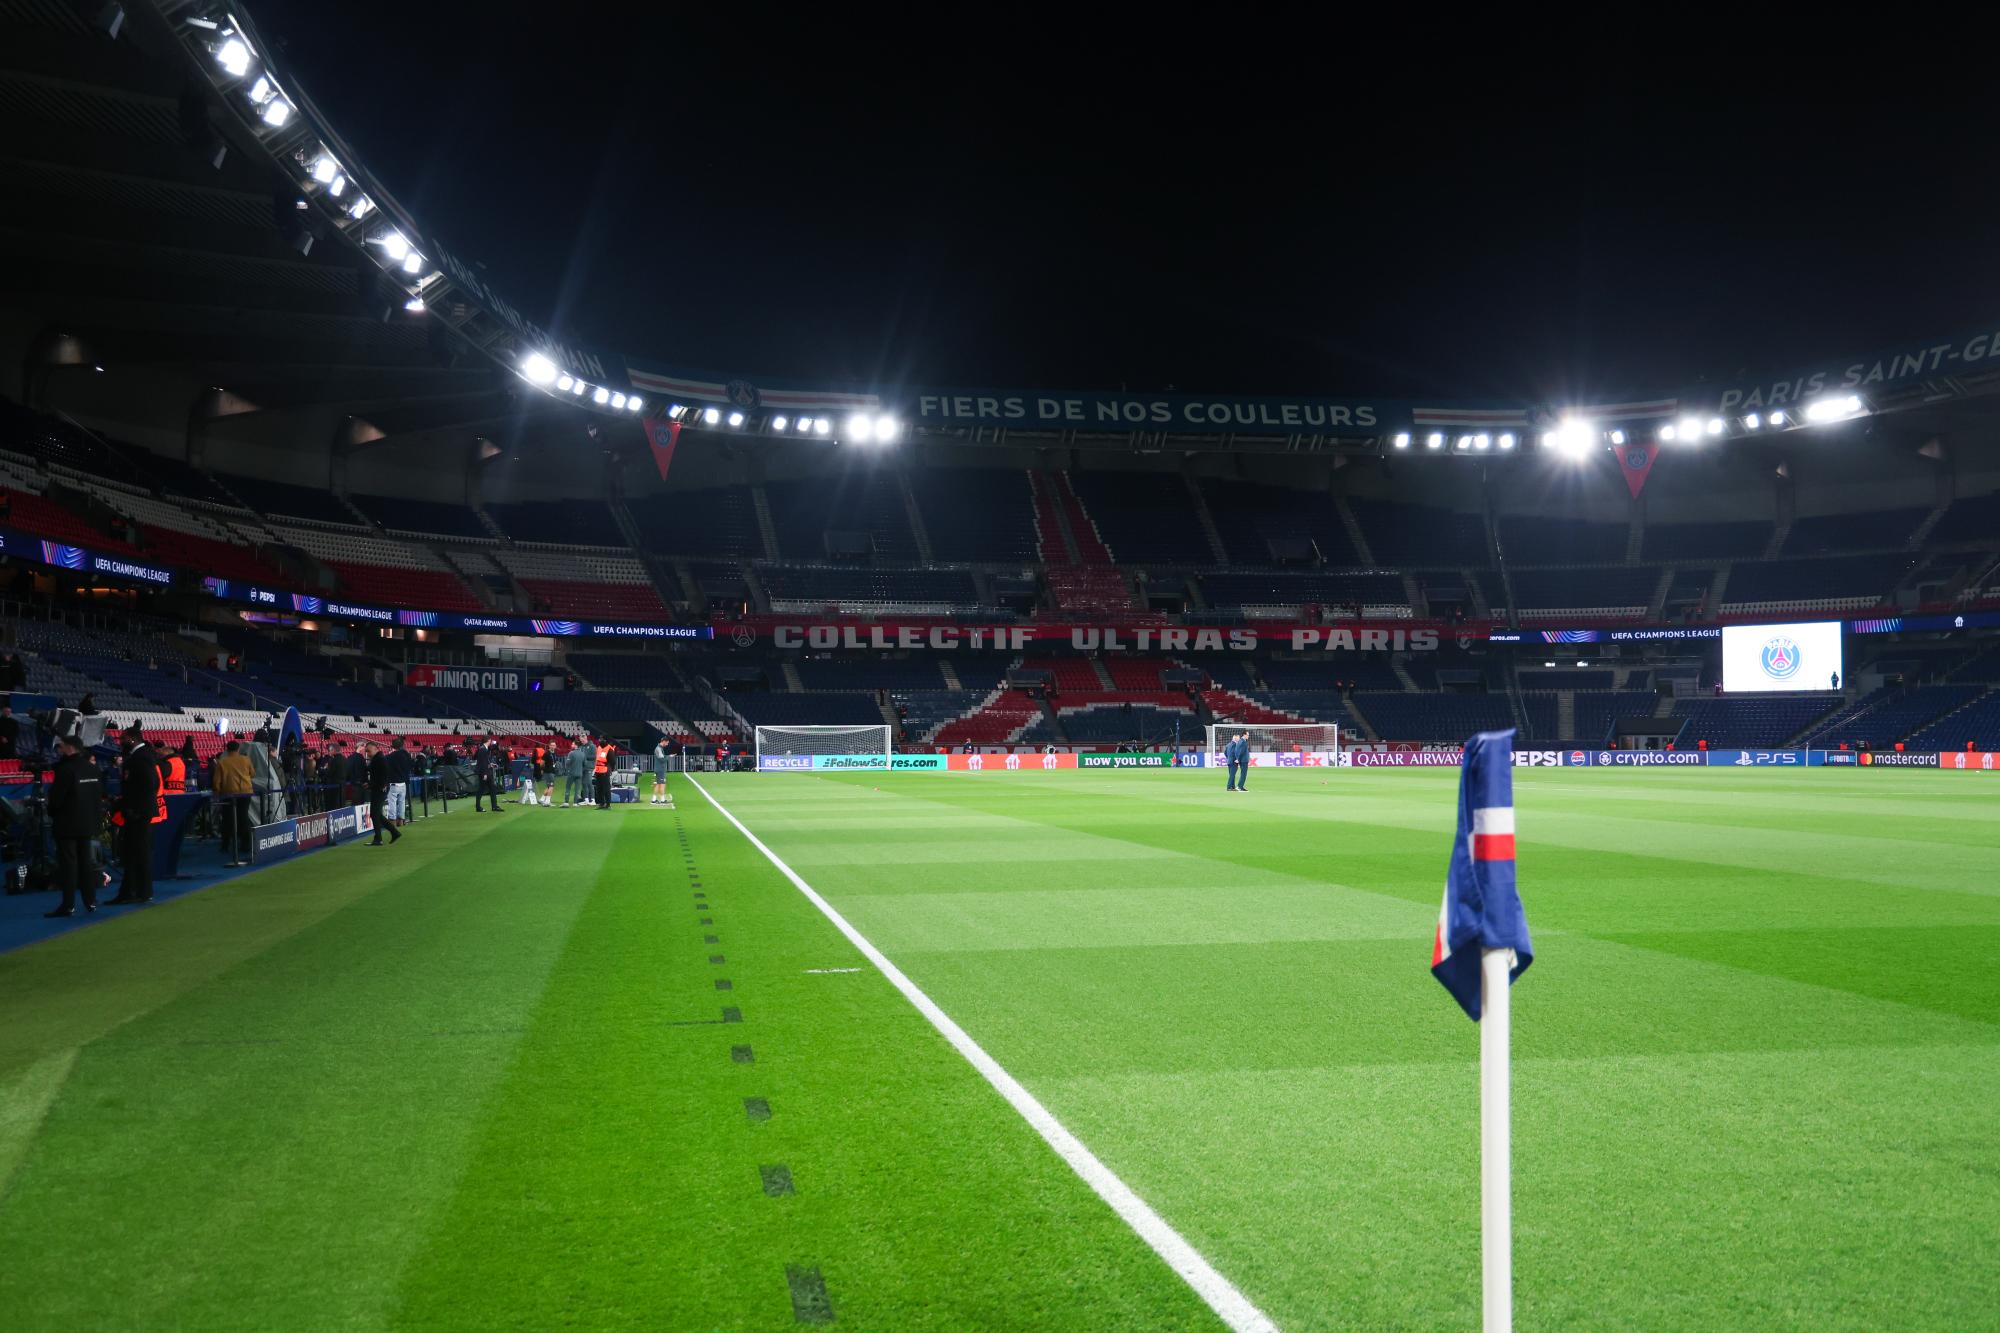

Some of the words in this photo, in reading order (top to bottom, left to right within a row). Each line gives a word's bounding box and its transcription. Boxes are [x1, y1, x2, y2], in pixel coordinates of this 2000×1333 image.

[1718, 372, 1826, 413] PARIS
[920, 396, 1026, 418] FIERS
[1039, 399, 1085, 420] DE
[1096, 401, 1172, 423] NOS
[1184, 403, 1377, 427] COULEURS
[95, 557, 112, 572] UEFA
[112, 561, 148, 580] CHAMPIONS
[147, 567, 170, 584] LEAGUE
[259, 591, 276, 603] PEPSI
[327, 603, 340, 614] UEFA
[339, 605, 372, 619] CHAMPIONS
[371, 609, 393, 621] LEAGUE
[463, 617, 482, 627] QATAR
[482, 618, 508, 628] AIRWAYS
[593, 625, 615, 635] UEFA
[616, 626, 665, 637] CHAMPIONS
[665, 627, 698, 638] LEAGUE
[774, 625, 1038, 650] COLLECTIF
[1071, 628, 1258, 651] ULTRAS
[1291, 629, 1440, 651] PARIS
[1611, 632, 1633, 640] UEFA
[1634, 631, 1685, 640] CHAMPIONS
[1686, 629, 1720, 638] LEAGUE
[430, 669, 480, 692] JUNIOR
[481, 671, 519, 691] CLUB
[765, 757, 809, 768] RECYCLE
[829, 757, 938, 768] FollowScres.com
[1084, 757, 1111, 766] now
[1113, 757, 1137, 769] you
[1139, 756, 1162, 766] can
[1182, 754, 1198, 767] 0.0
[1275, 752, 1323, 767] FedEx
[1357, 753, 1404, 767] QATAR
[1616, 752, 1699, 766] crypto.com
[1756, 753, 1796, 764] PS5
[1874, 753, 1937, 765] mastercard
